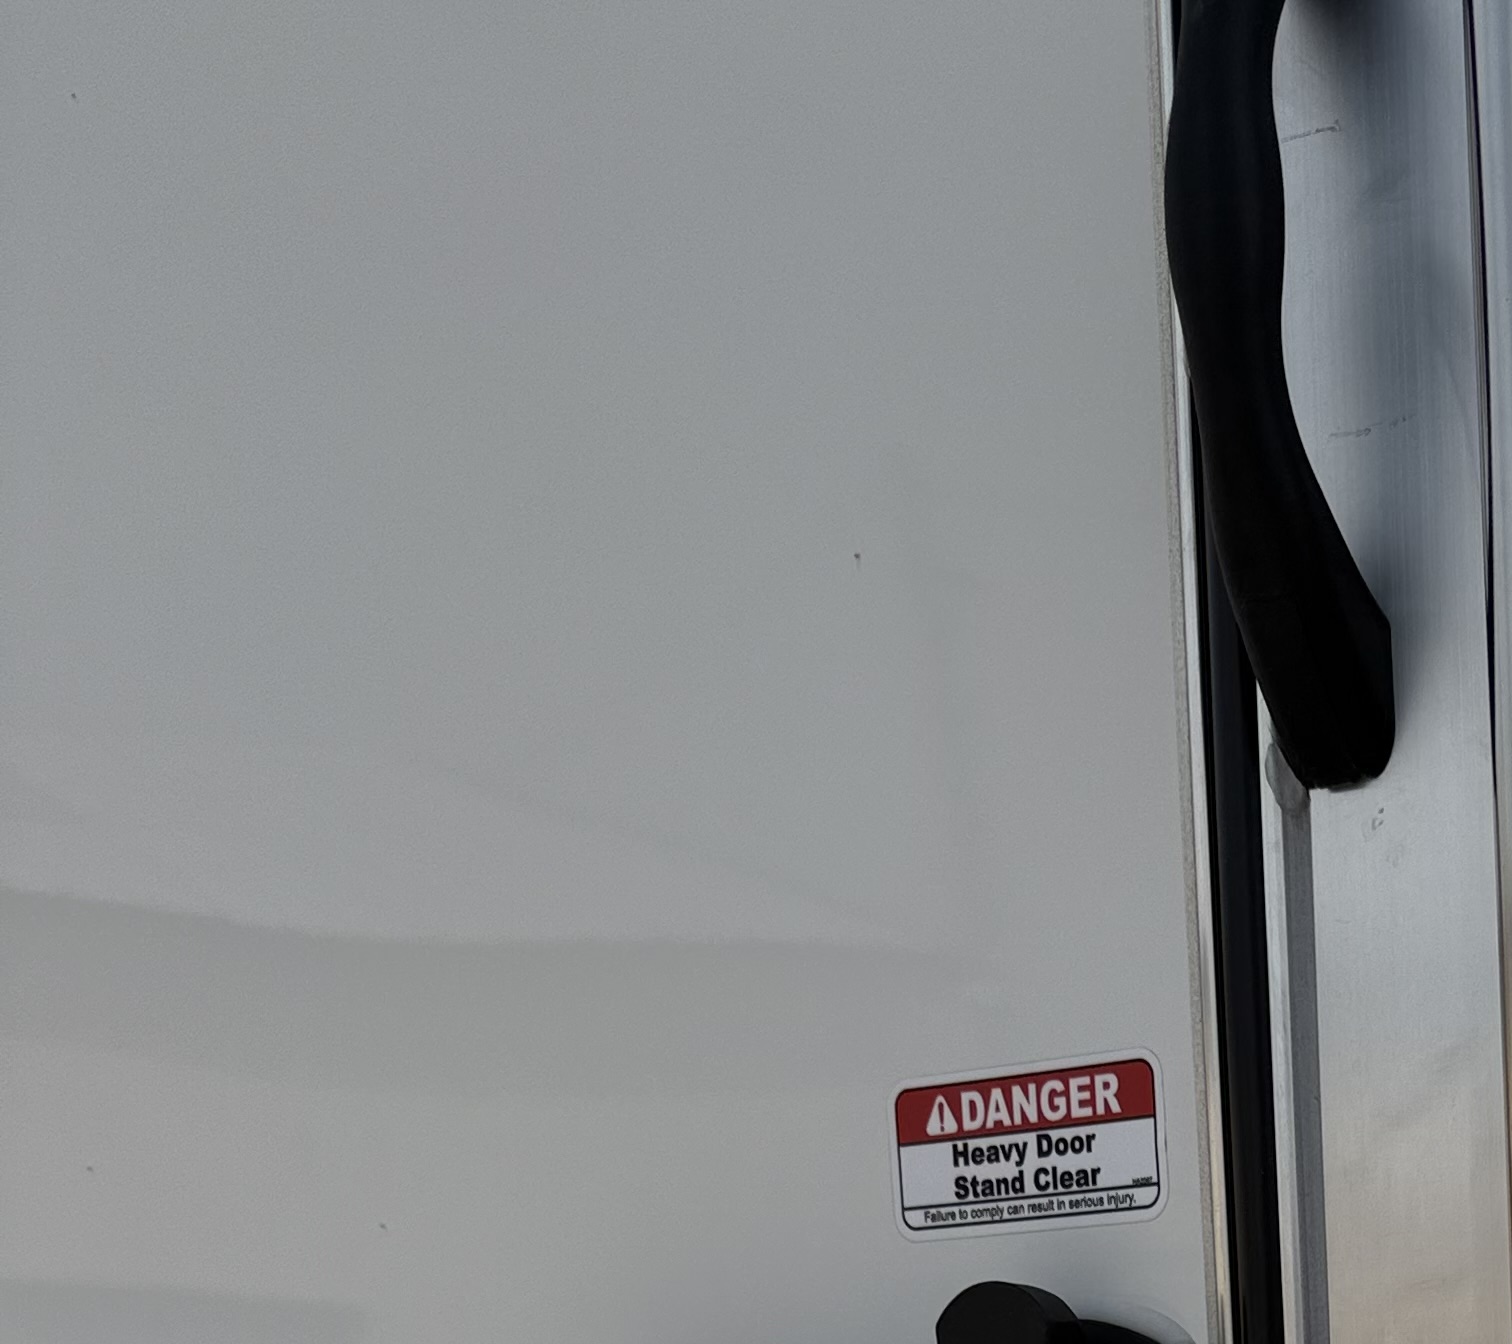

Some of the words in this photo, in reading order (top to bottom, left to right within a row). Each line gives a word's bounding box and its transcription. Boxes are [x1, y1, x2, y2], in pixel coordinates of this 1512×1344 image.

[959, 1072, 1122, 1131] DANGER
[952, 1141, 1028, 1168] Heavy
[1036, 1133, 1096, 1159] Door
[954, 1170, 1025, 1200] Stand
[1033, 1165, 1102, 1192] Clear
[924, 1210, 957, 1225] Failure
[959, 1208, 970, 1220] to
[971, 1205, 1004, 1221] comply
[1007, 1204, 1025, 1216] can
[1027, 1199, 1055, 1212] result
[1057, 1199, 1066, 1210] in
[1069, 1195, 1104, 1209] serious
[1106, 1191, 1137, 1208] injury.
